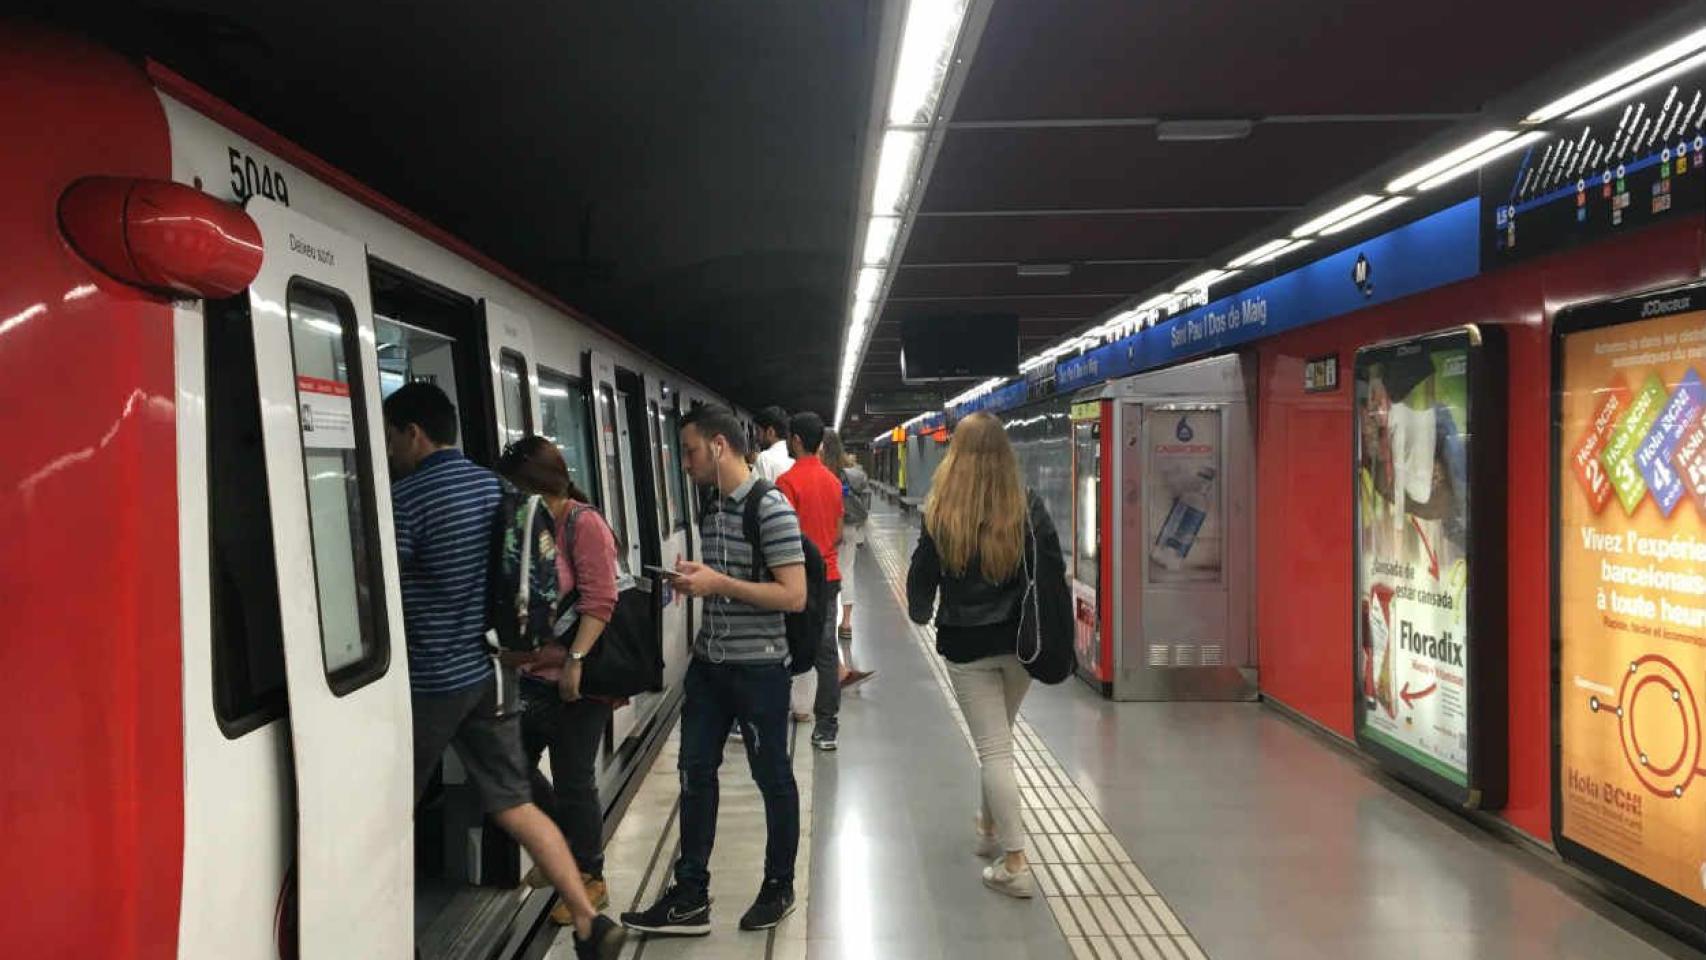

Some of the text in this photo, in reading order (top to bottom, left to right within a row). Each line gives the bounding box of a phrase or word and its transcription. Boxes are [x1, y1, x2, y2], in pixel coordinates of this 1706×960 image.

[227, 146, 289, 208] 5049
[1187, 319, 1203, 344] Pau
[1208, 310, 1227, 337] Dos
[1227, 303, 1240, 330] de
[1241, 295, 1267, 327] Maig
[1639, 430, 1665, 467] Hola
[1676, 429, 1705, 467] Hola
[1585, 458, 1605, 494] 2
[1616, 459, 1636, 492] 3
[1653, 457, 1672, 491] 4
[1581, 526, 1623, 554] Vivez
[1395, 585, 1416, 601] estar
[1417, 590, 1453, 610] cansada
[1596, 587, 1606, 611] à
[1611, 589, 1655, 620] toute
[1400, 619, 1464, 668] Floradix
[1567, 765, 1599, 801] Hola
